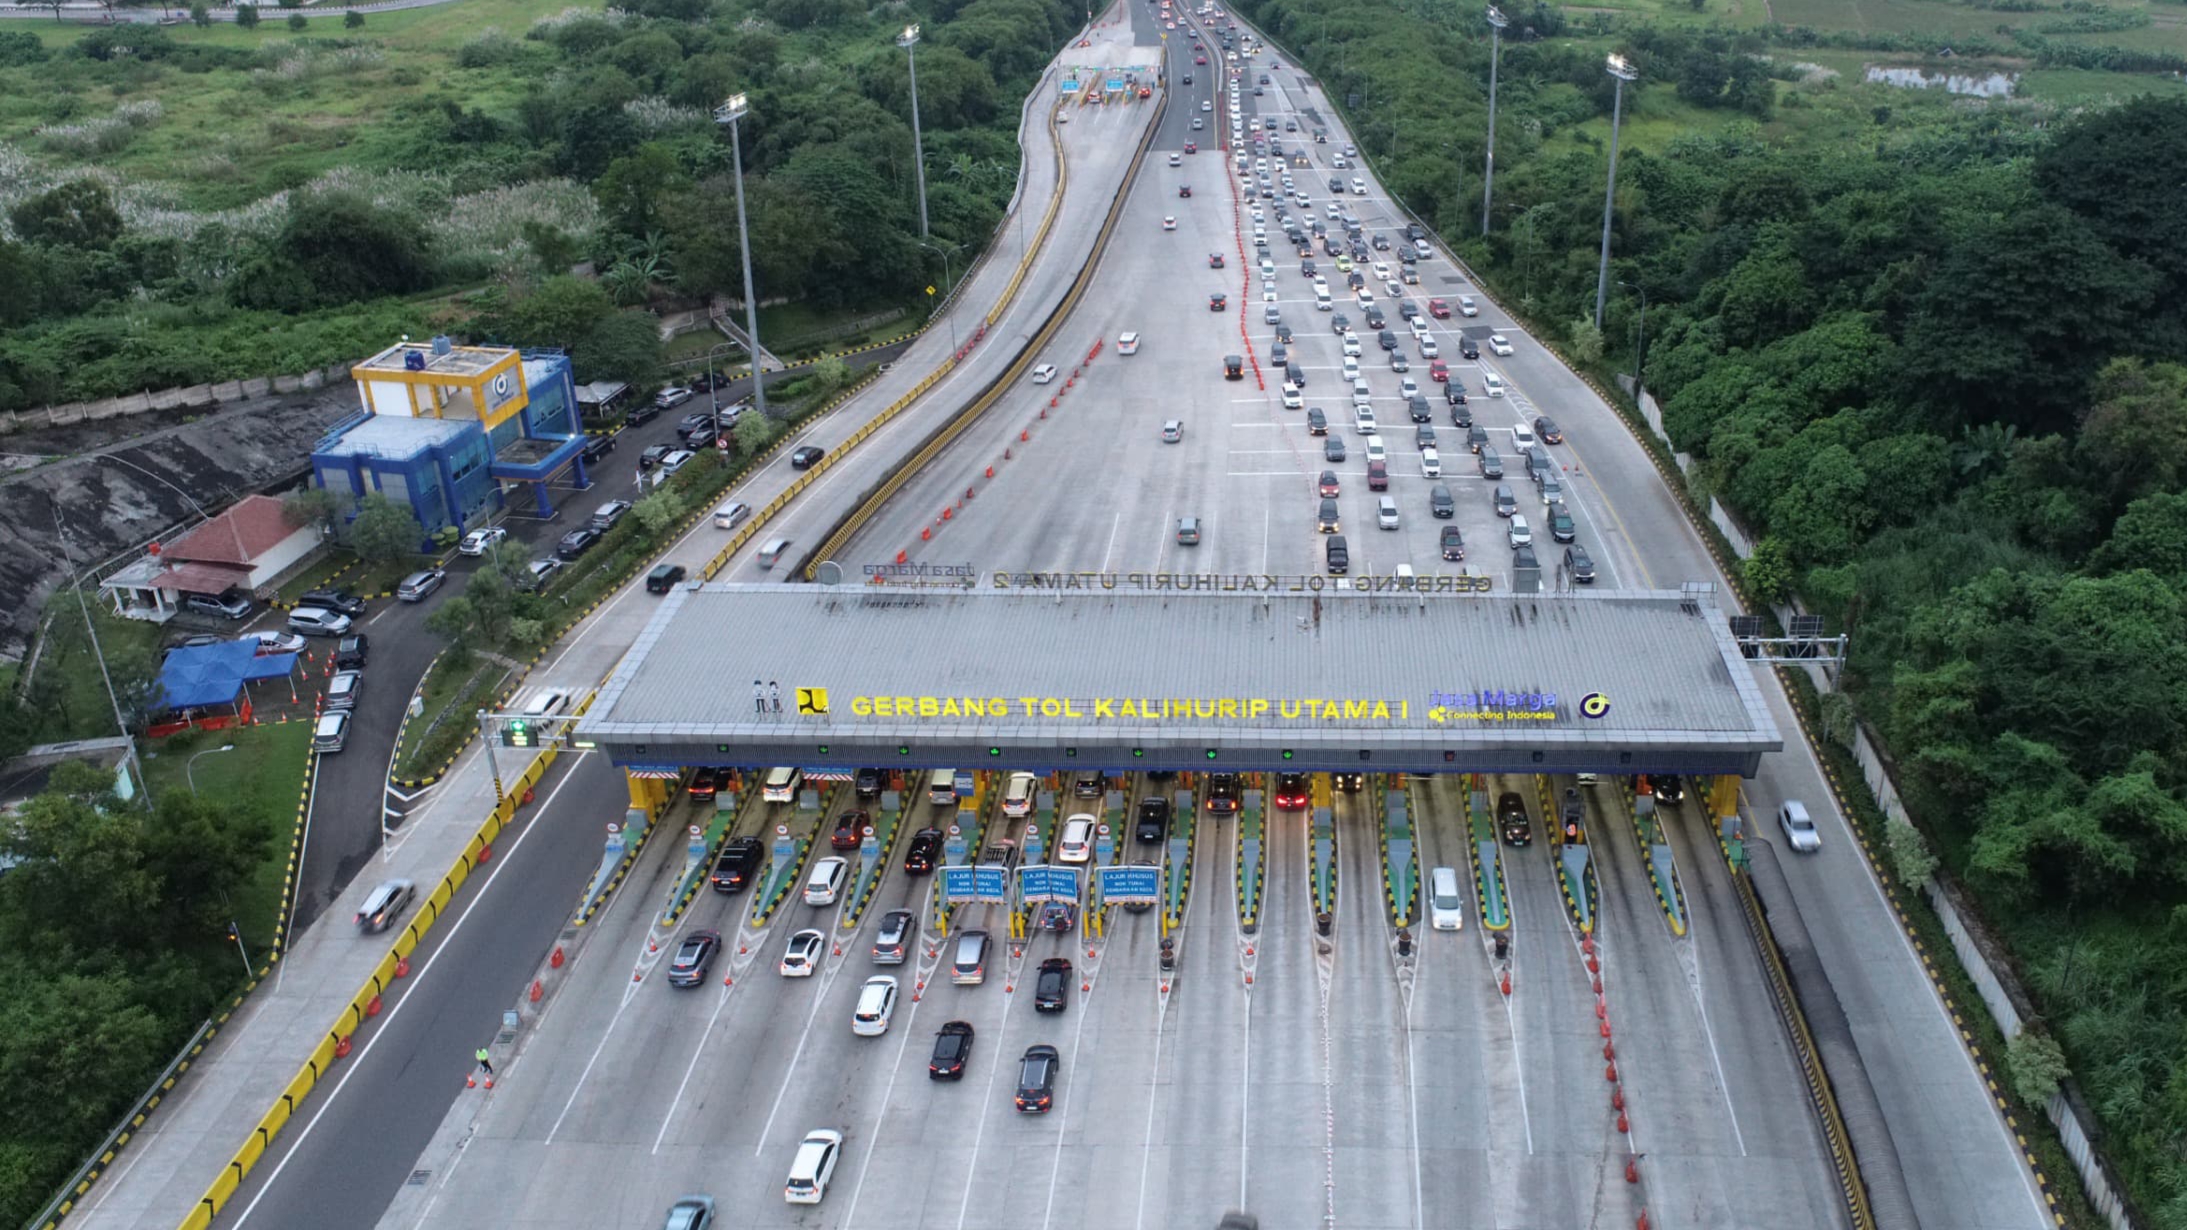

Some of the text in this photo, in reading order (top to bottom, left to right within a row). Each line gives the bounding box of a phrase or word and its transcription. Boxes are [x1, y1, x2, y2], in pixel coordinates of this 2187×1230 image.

[851, 696, 1009, 717] GERBANG
[1019, 697, 1083, 717] TOL
[1095, 697, 1269, 718] KALIHURIP
[1280, 698, 1391, 719] UTAMA
[1429, 689, 1557, 710] Jasa Marga
[1446, 710, 1556, 721] Connecting Indonesia
